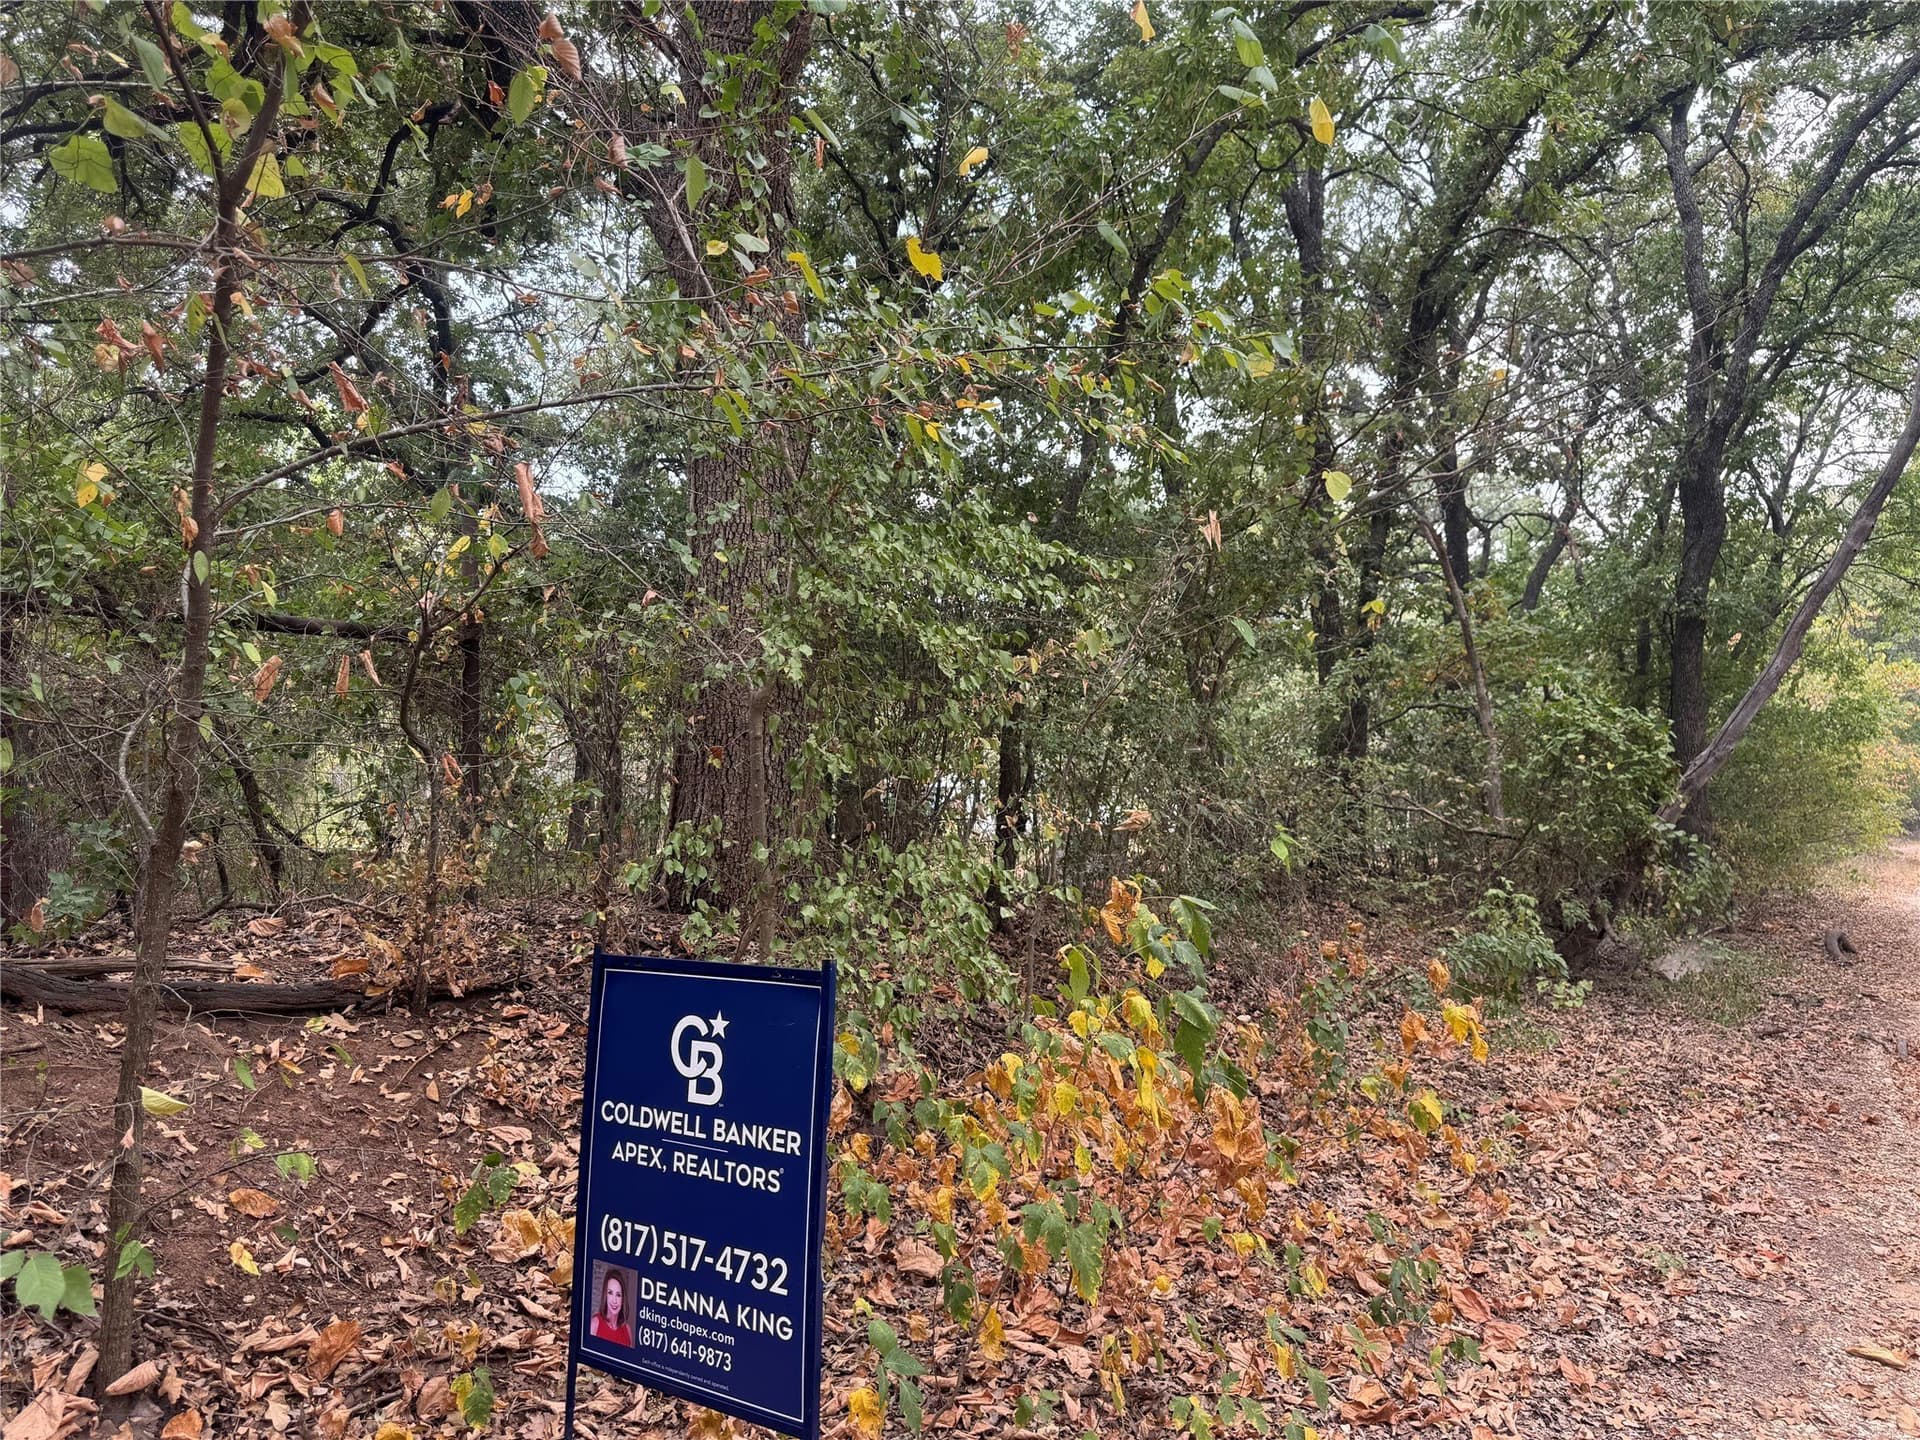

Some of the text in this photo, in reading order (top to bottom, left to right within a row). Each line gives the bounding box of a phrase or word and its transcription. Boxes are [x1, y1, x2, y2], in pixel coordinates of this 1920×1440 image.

[601, 1100, 802, 1156] COLDWELL BANKER
[611, 1140, 667, 1173] APEX,
[639, 1307, 735, 1346] dking.cbapex.com
[640, 1277, 793, 1341] DEANNA KING
[638, 1325, 732, 1372] (817) 641-9873
